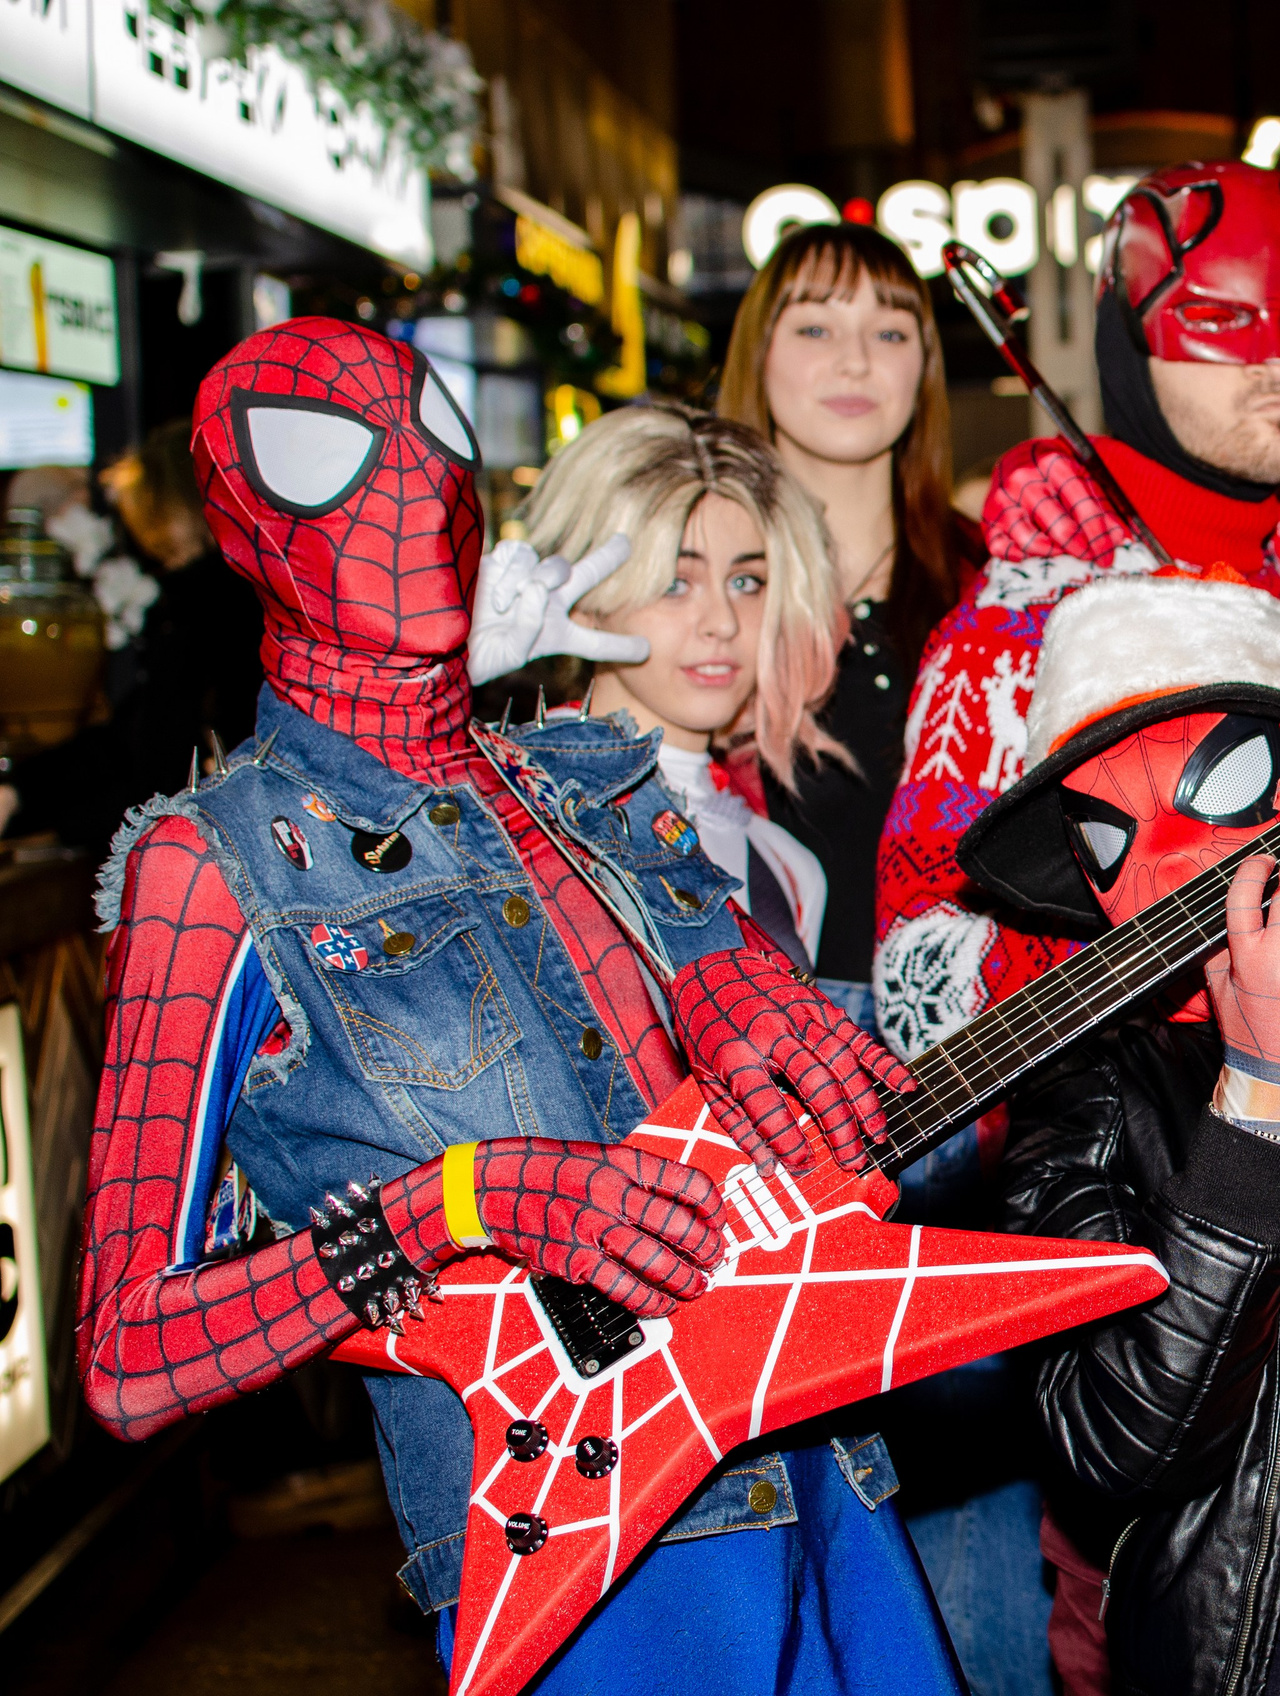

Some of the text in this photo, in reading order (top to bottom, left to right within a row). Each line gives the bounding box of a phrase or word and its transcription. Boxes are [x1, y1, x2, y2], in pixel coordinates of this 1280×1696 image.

[511, 1428, 528, 1436] TONE
[583, 1440, 596, 1456] TONE
[508, 1520, 531, 1530] VOLUME
